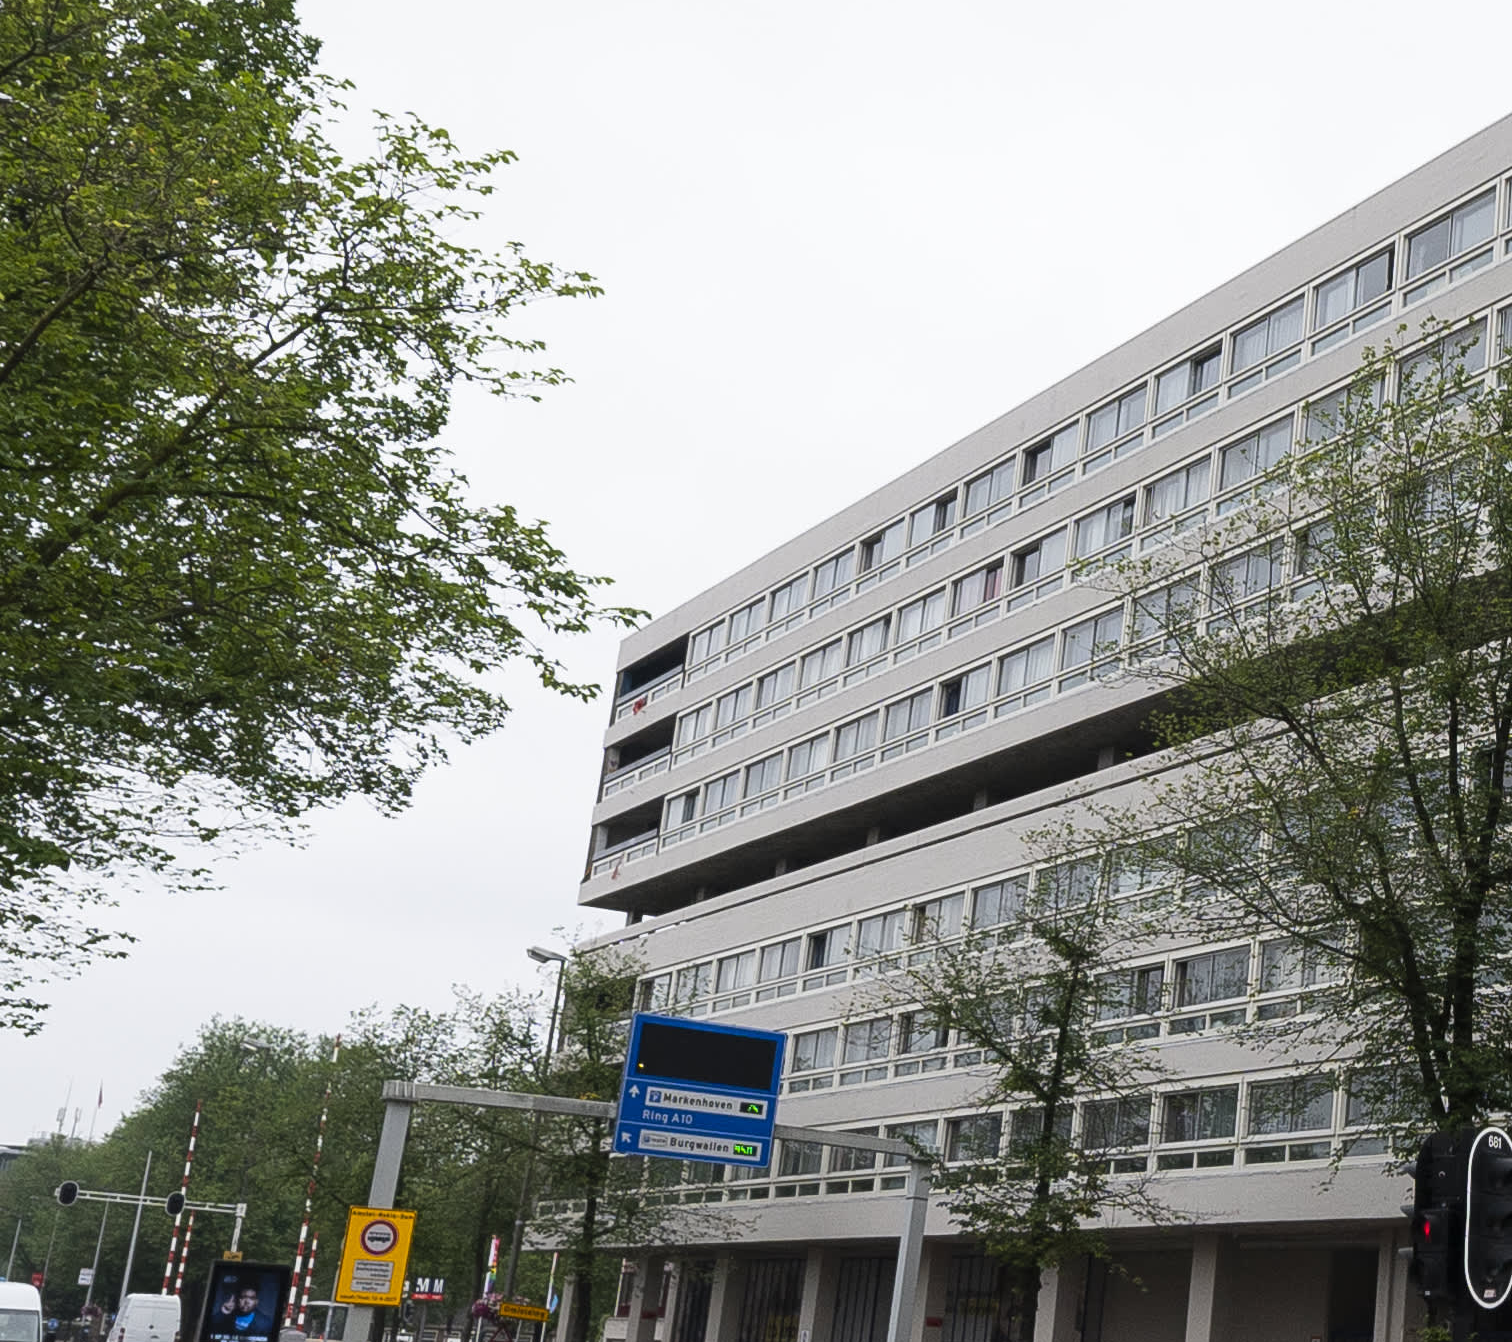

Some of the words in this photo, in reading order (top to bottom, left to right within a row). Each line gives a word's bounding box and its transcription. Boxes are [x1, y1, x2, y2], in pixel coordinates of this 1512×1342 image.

[663, 1092, 733, 1110] Markenhoven
[642, 1109, 668, 1124] Ring
[671, 1113, 693, 1125] A10
[669, 1137, 729, 1152] Burgwallen
[1488, 1135, 1502, 1149] 681
